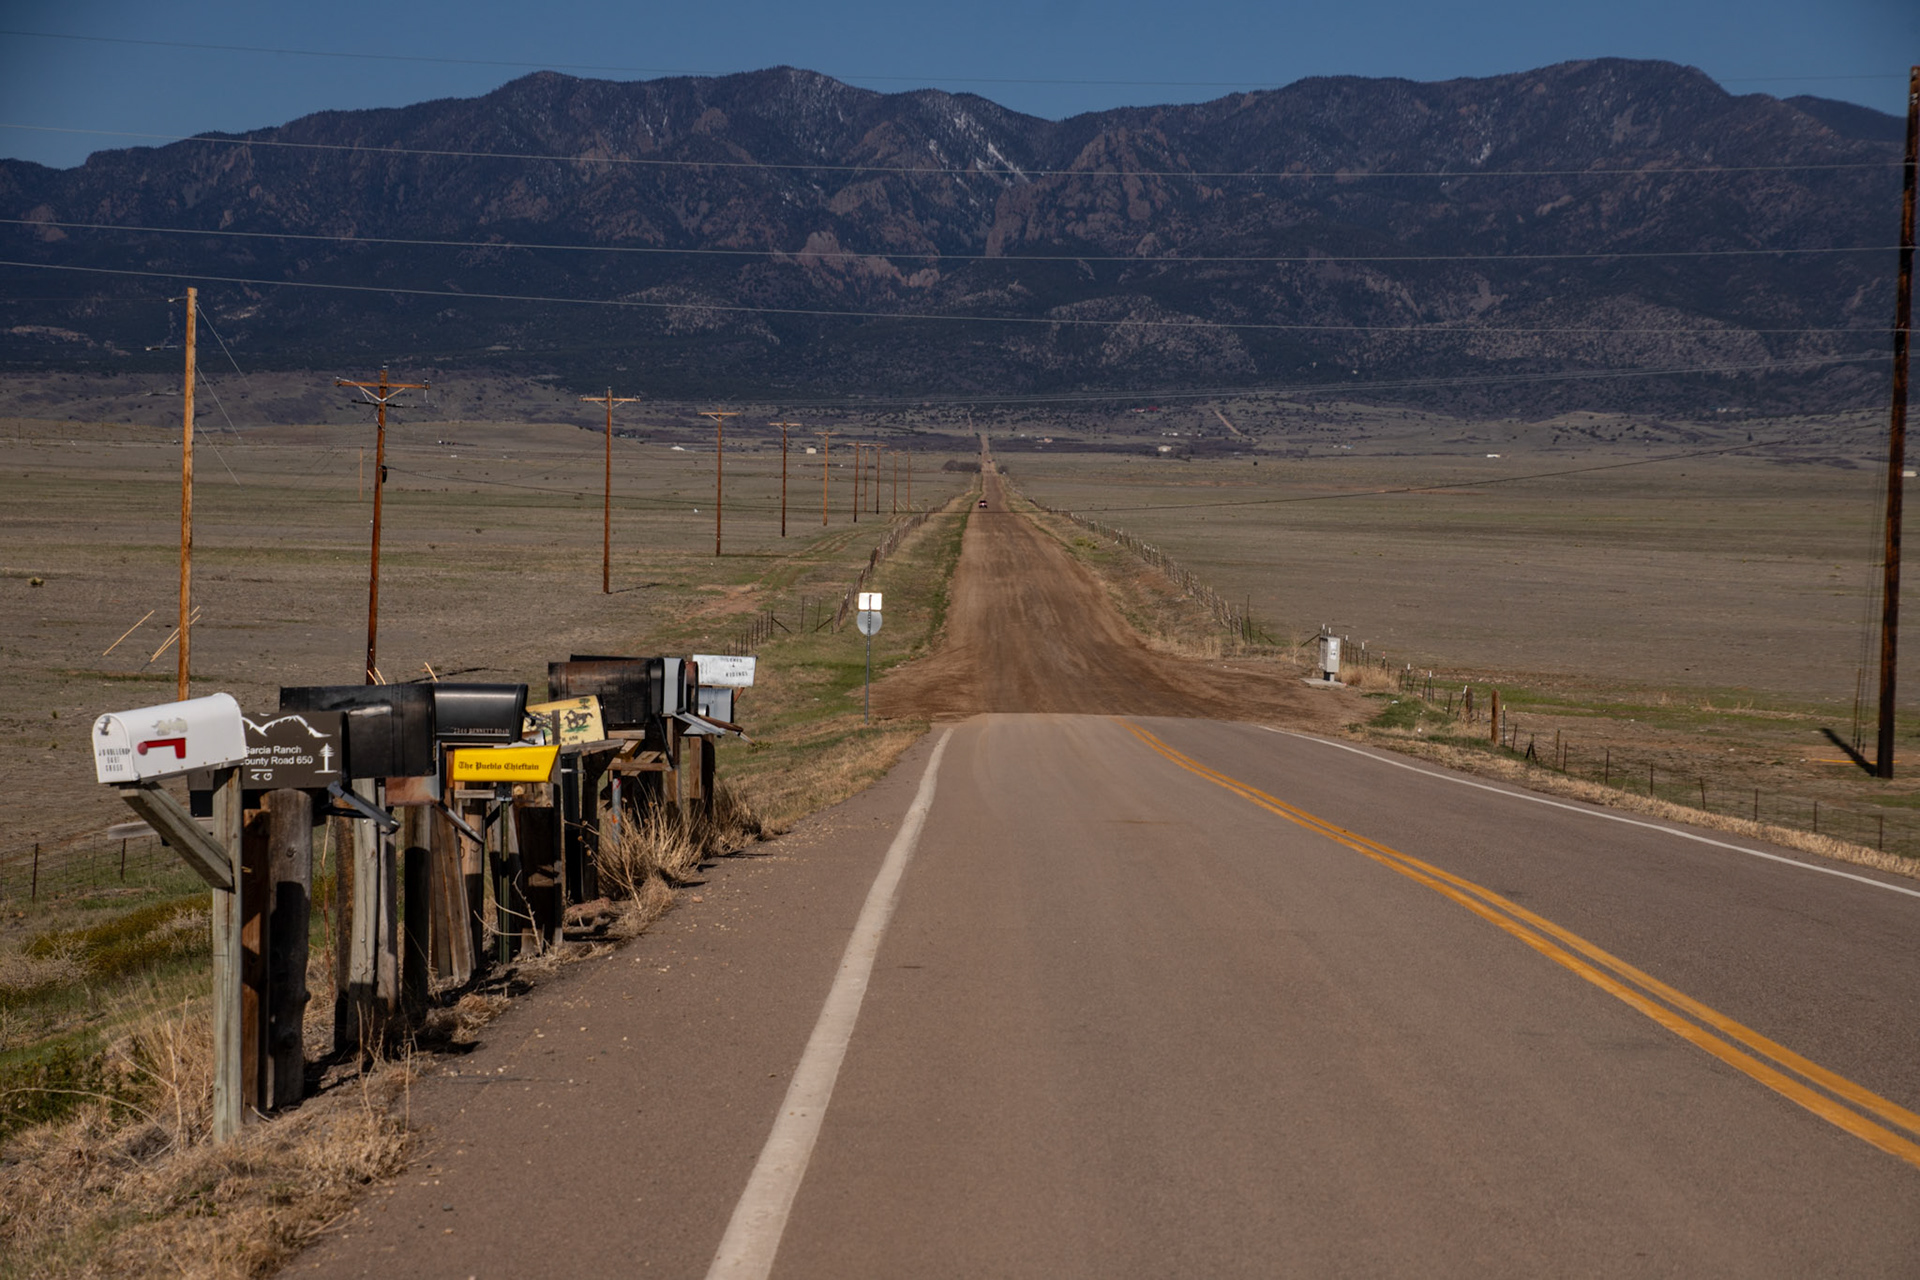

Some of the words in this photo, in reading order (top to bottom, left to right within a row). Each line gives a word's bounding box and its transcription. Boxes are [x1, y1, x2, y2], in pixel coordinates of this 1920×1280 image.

[273, 746, 302, 754] Ranch
[241, 757, 269, 767] ounty
[271, 757, 294, 765] Road
[296, 756, 313, 765] 650
[458, 762, 473, 770] The
[475, 762, 502, 771] Pueblo
[503, 762, 539, 771] Chieftain
